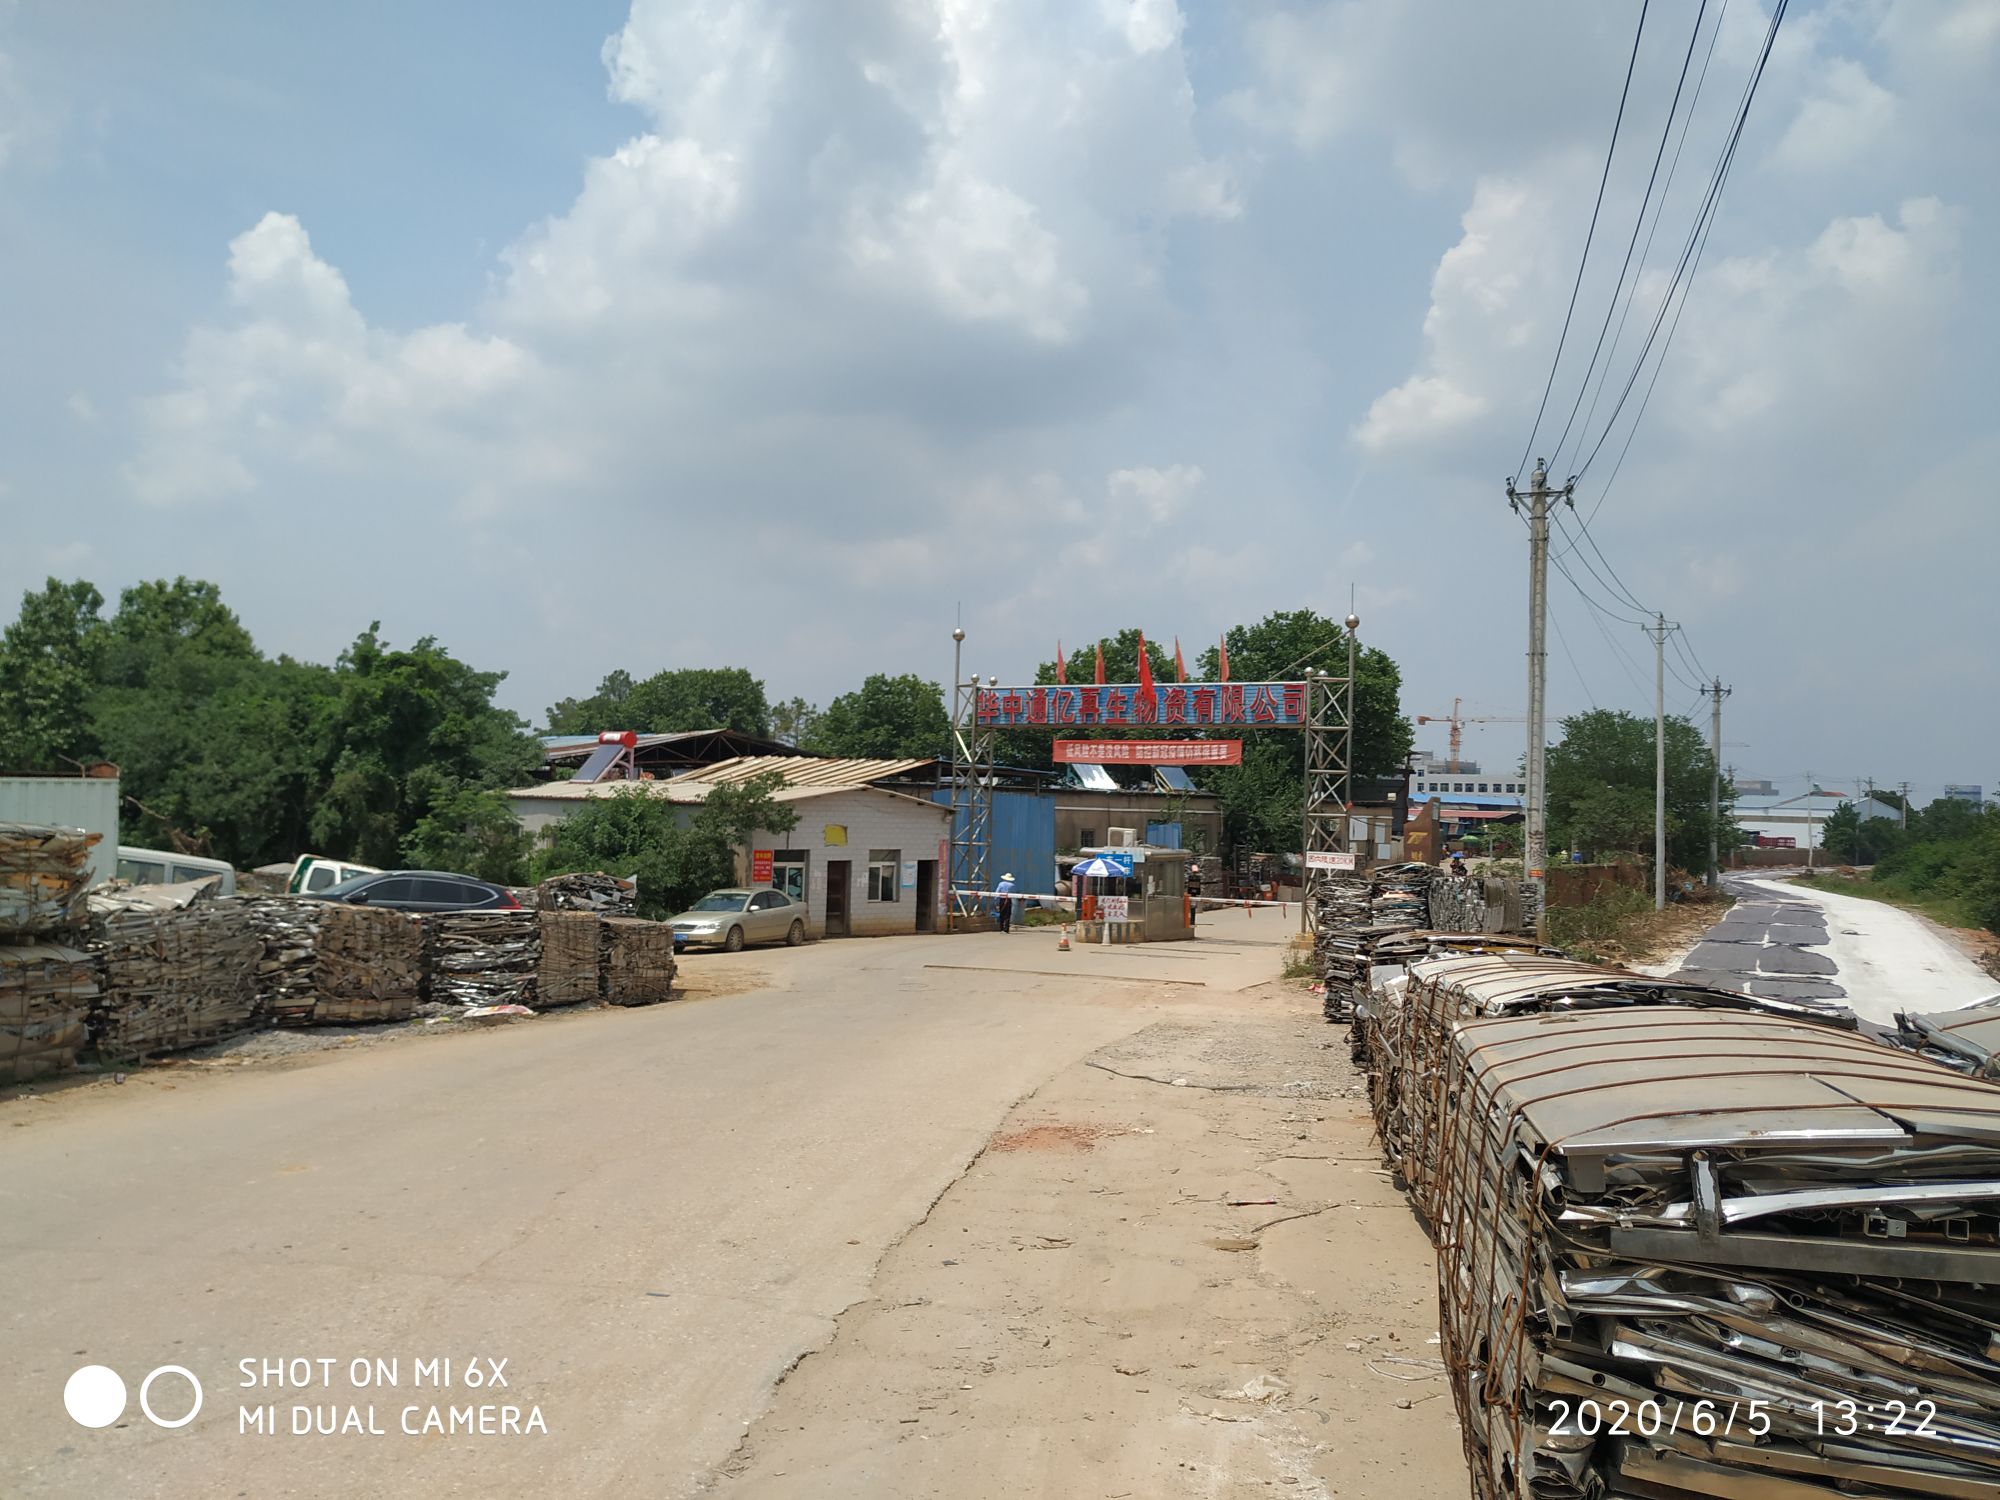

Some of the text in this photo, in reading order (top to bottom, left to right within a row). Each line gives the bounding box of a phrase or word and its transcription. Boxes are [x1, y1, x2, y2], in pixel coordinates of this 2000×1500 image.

[977, 685, 1306, 725] 华中通亿再生物资有限公司
